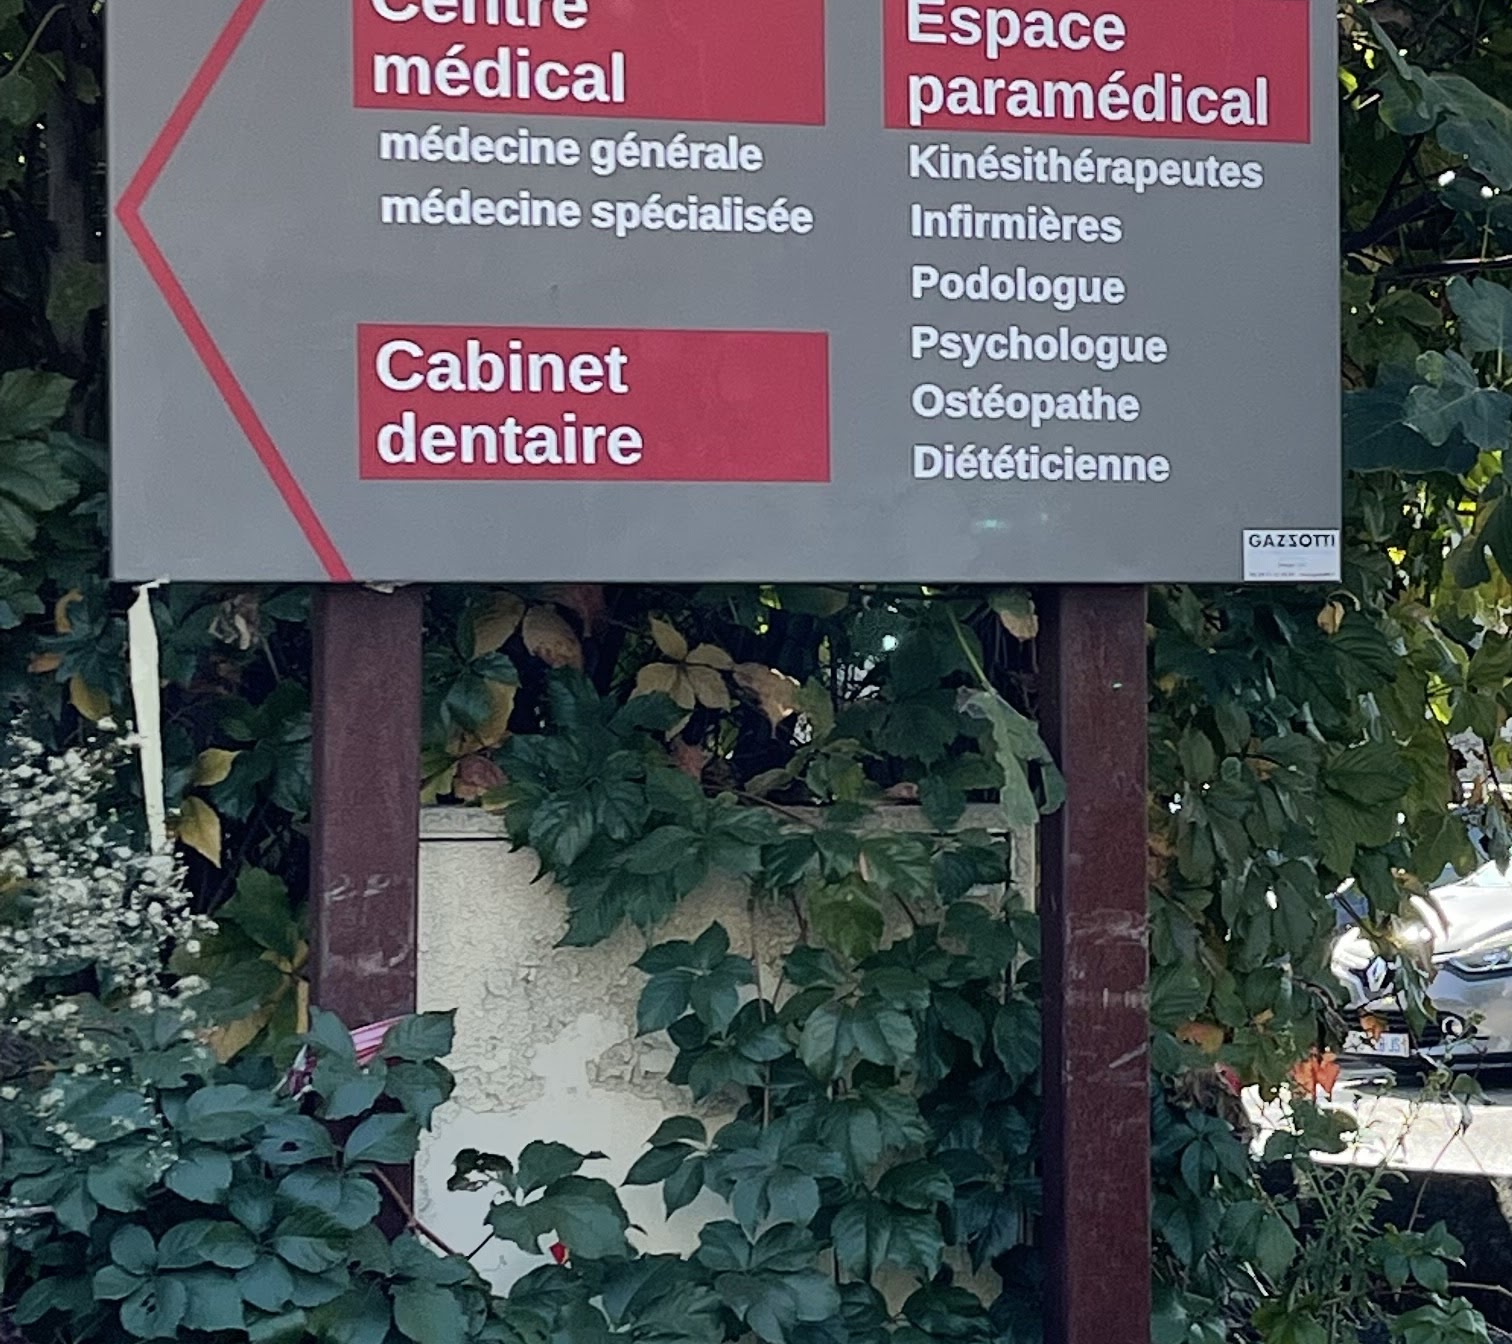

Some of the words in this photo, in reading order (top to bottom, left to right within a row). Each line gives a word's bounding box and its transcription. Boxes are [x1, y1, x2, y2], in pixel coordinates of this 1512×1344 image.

[373, 44, 625, 103] médical
[908, 70, 1269, 126] paramédical
[379, 125, 580, 166] médecine
[590, 133, 764, 175] générale
[908, 144, 1264, 193] Kinésithérapeutes
[380, 188, 581, 228] médecine
[591, 193, 814, 237] spécialisée
[911, 203, 1123, 243] Infirmières
[911, 264, 1126, 311] Podologue
[375, 338, 629, 393] Cabinet
[911, 325, 1168, 370] Psychologue
[912, 383, 1141, 427] Ostéopathe
[376, 410, 643, 465] dentaire
[913, 444, 1170, 483] Diététicienne
[1248, 534, 1335, 548] GAZZOTTI
